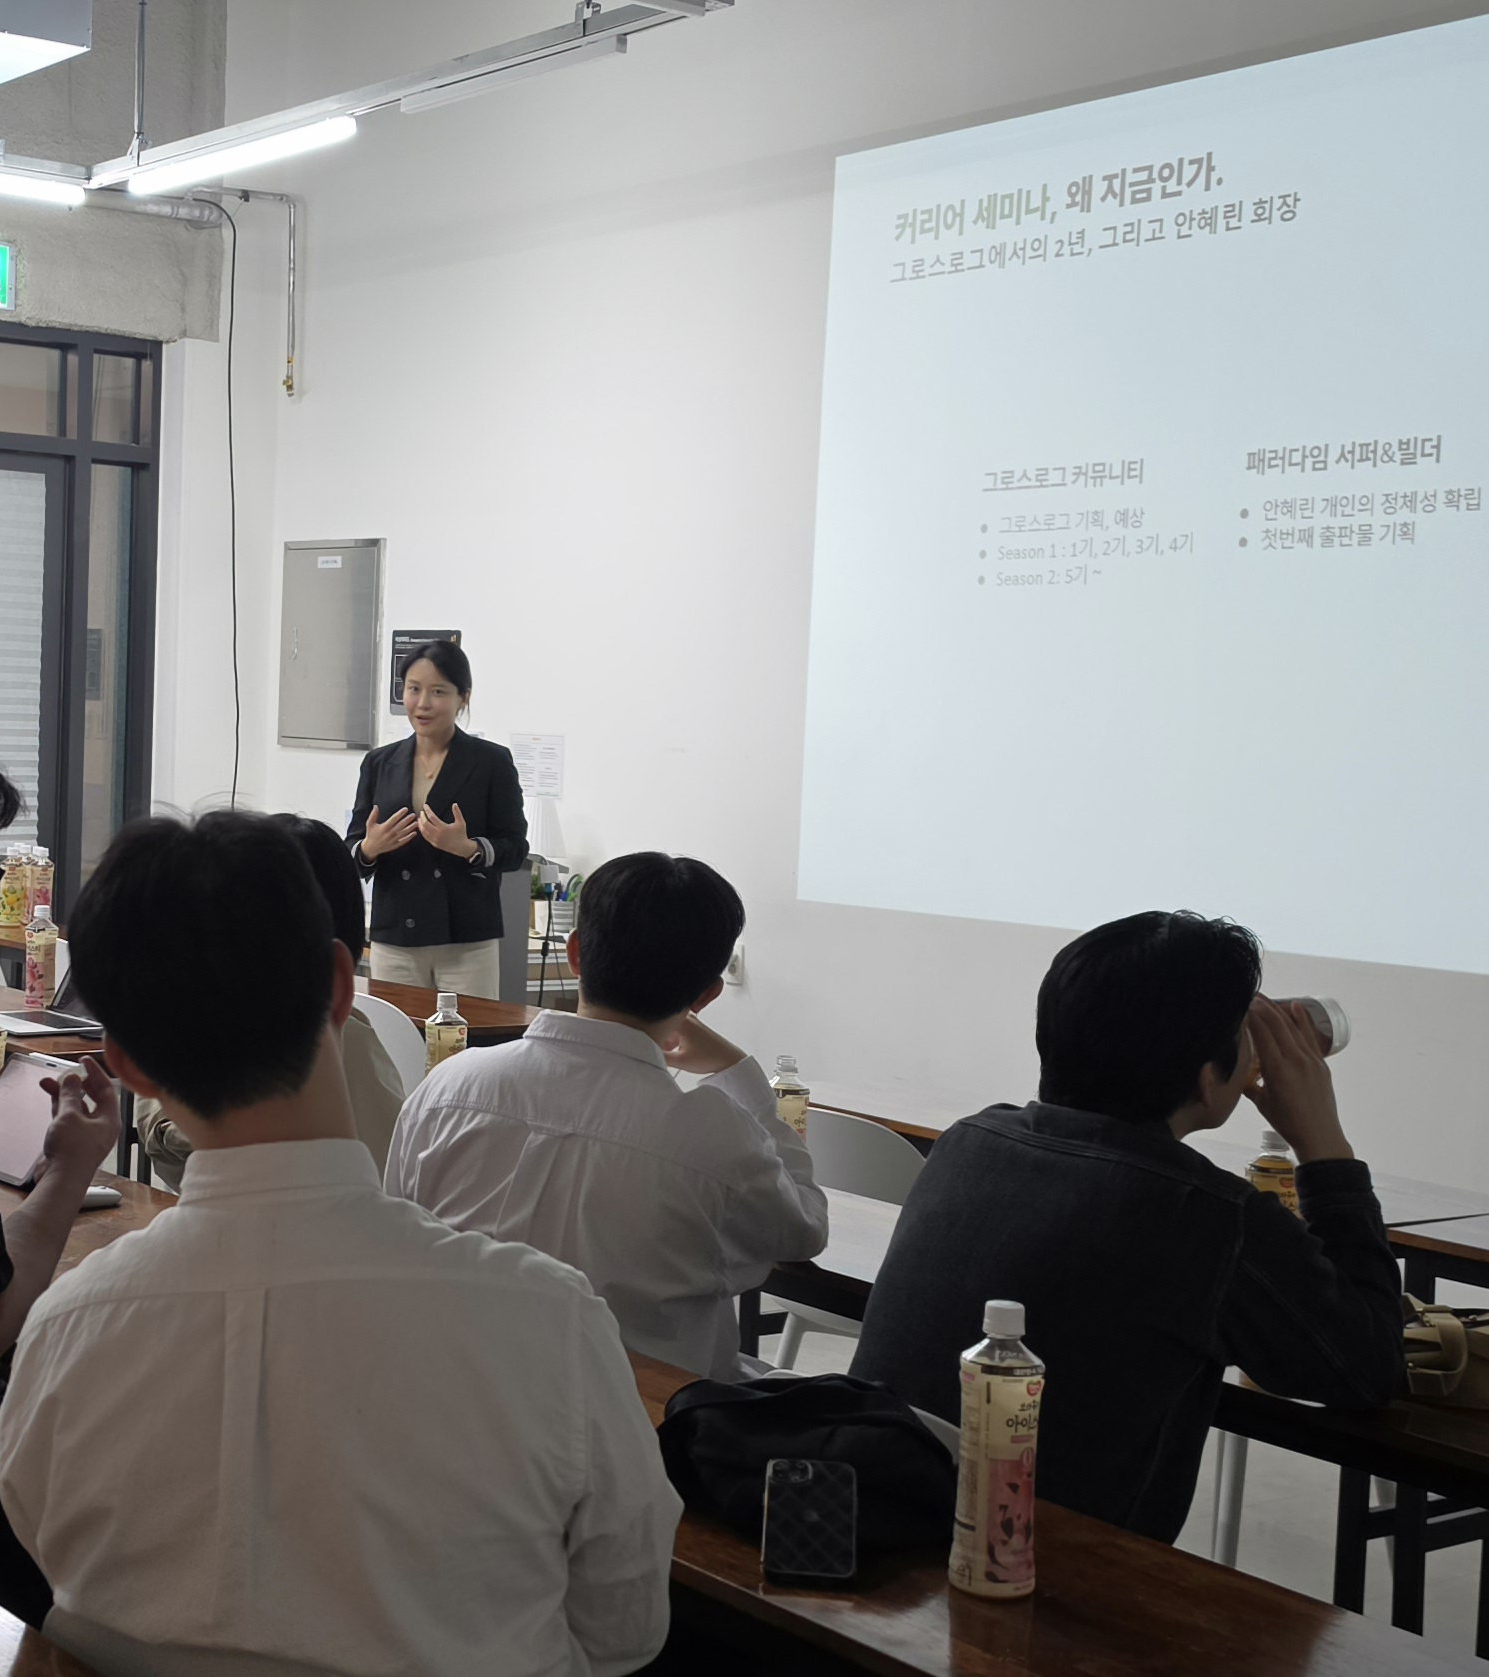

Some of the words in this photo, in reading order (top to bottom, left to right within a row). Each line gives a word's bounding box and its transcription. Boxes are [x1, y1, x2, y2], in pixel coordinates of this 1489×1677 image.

[894, 199, 965, 244] 커리어
[972, 183, 1057, 230] 세미나,
[1065, 174, 1093, 213] 왜
[1100, 151, 1223, 207] 지금인가.
[890, 234, 1048, 283] 그로스로그에서의
[1054, 228, 1093, 258] 2년,
[1098, 218, 1165, 249] 그리고
[1174, 200, 1243, 240] 안혜린
[1250, 191, 1301, 225] 회장
[1246, 443, 1329, 476] 패러다임
[1334, 434, 1442, 470] 서퍼&빌더
[982, 466, 1067, 492] 그로스로그
[1071, 458, 1144, 488] 커뮤니티
[998, 513, 1071, 533] 그로스로그
[1075, 509, 1110, 532] 기획,
[1114, 507, 1145, 529] 예상
[1262, 496, 1315, 522] 안혜린
[1320, 492, 1375, 519] 개인의
[1380, 489, 1437, 516] 정체성
[1443, 487, 1482, 513] 확립
[997, 545, 1045, 560] Season
[1070, 536, 1098, 559] 1기,
[1102, 535, 1131, 558] 2기,
[1135, 533, 1164, 556] 3기,
[1168, 531, 1194, 554] 4기
[1261, 525, 1314, 551] 첫번째
[1318, 522, 1375, 549] 출판물
[1379, 520, 1416, 546] 기획
[996, 571, 1043, 586] Season
[1047, 570, 1060, 585] 2:
[1064, 563, 1088, 585] 5기
